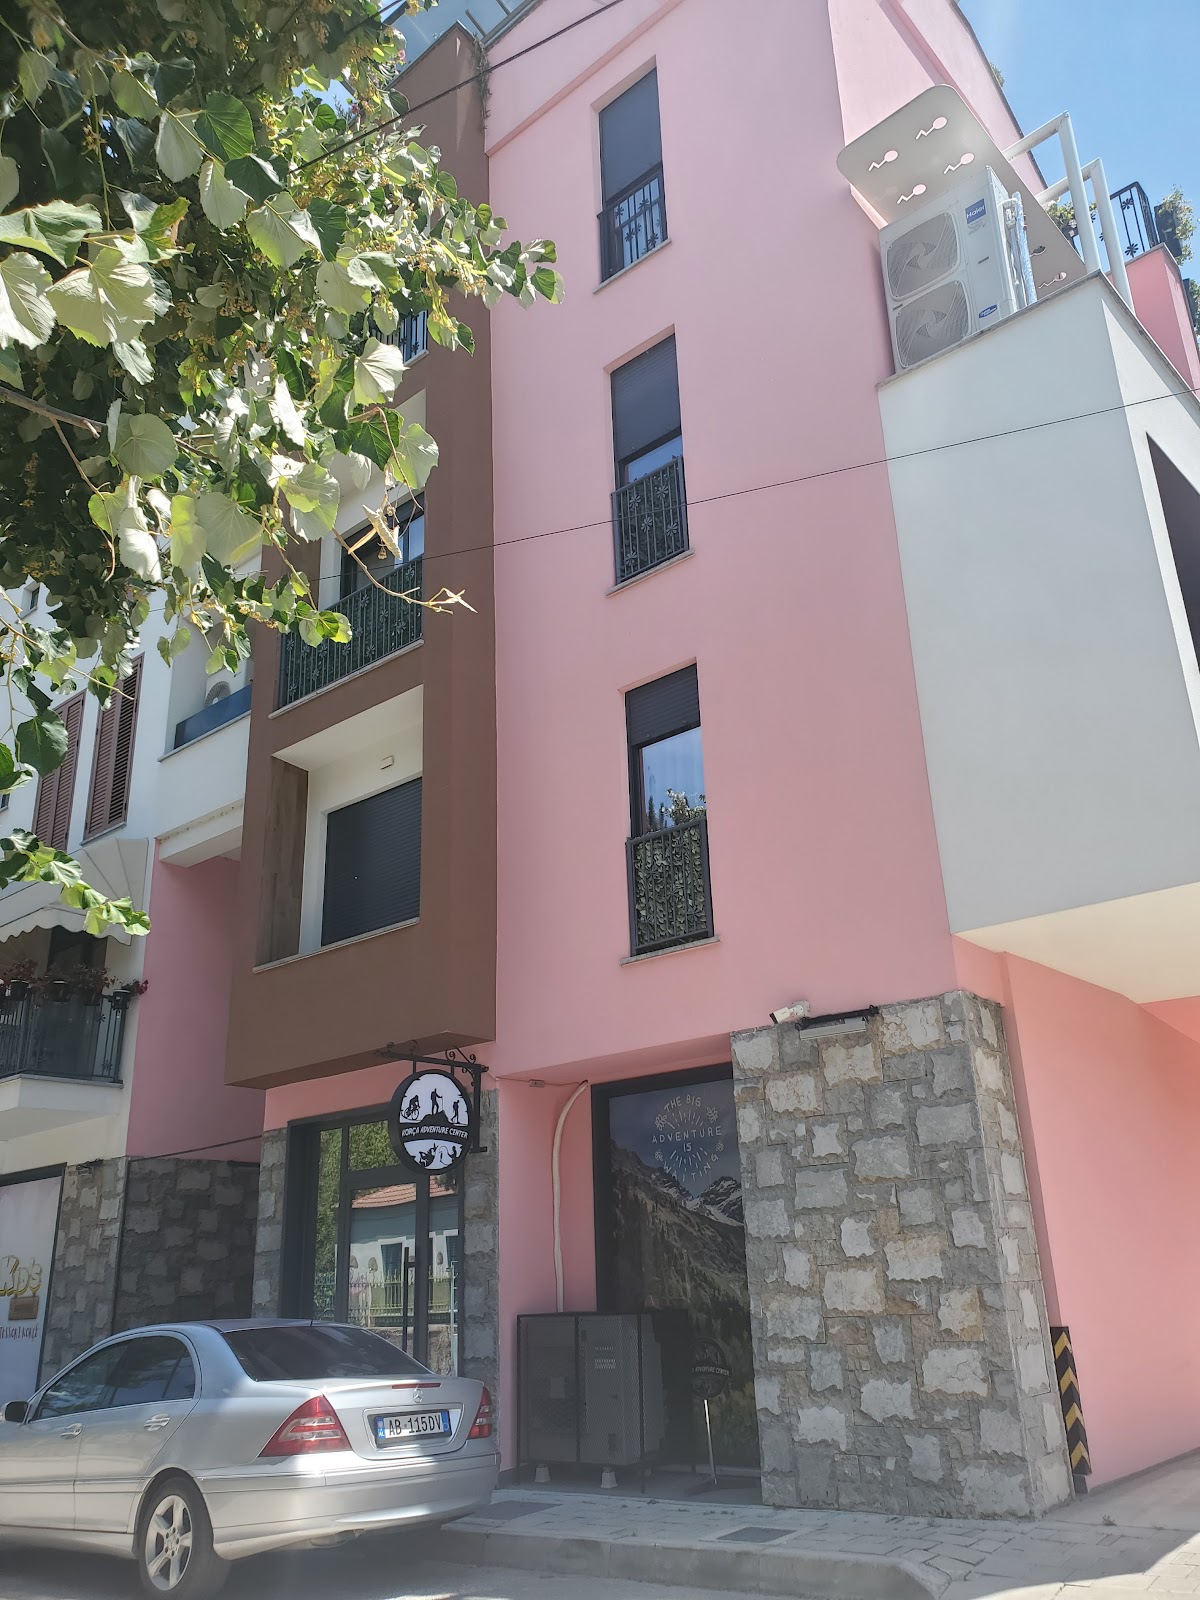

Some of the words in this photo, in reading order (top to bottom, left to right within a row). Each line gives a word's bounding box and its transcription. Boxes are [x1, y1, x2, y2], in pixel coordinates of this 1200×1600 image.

[966, 205, 985, 219] Haier
[664, 1096, 682, 1113] THE
[686, 1095, 701, 1108] BIG
[402, 1127, 420, 1138] KORÇA
[420, 1126, 449, 1135] ADVENTURE
[449, 1128, 469, 1139] CENTER
[652, 1126, 722, 1144] ADVENTURE
[683, 1142, 692, 1153] IS
[663, 1153, 719, 1182] WAITING
[389, 1419, 402, 1436] AB
[408, 1415, 441, 1433] 115DV
